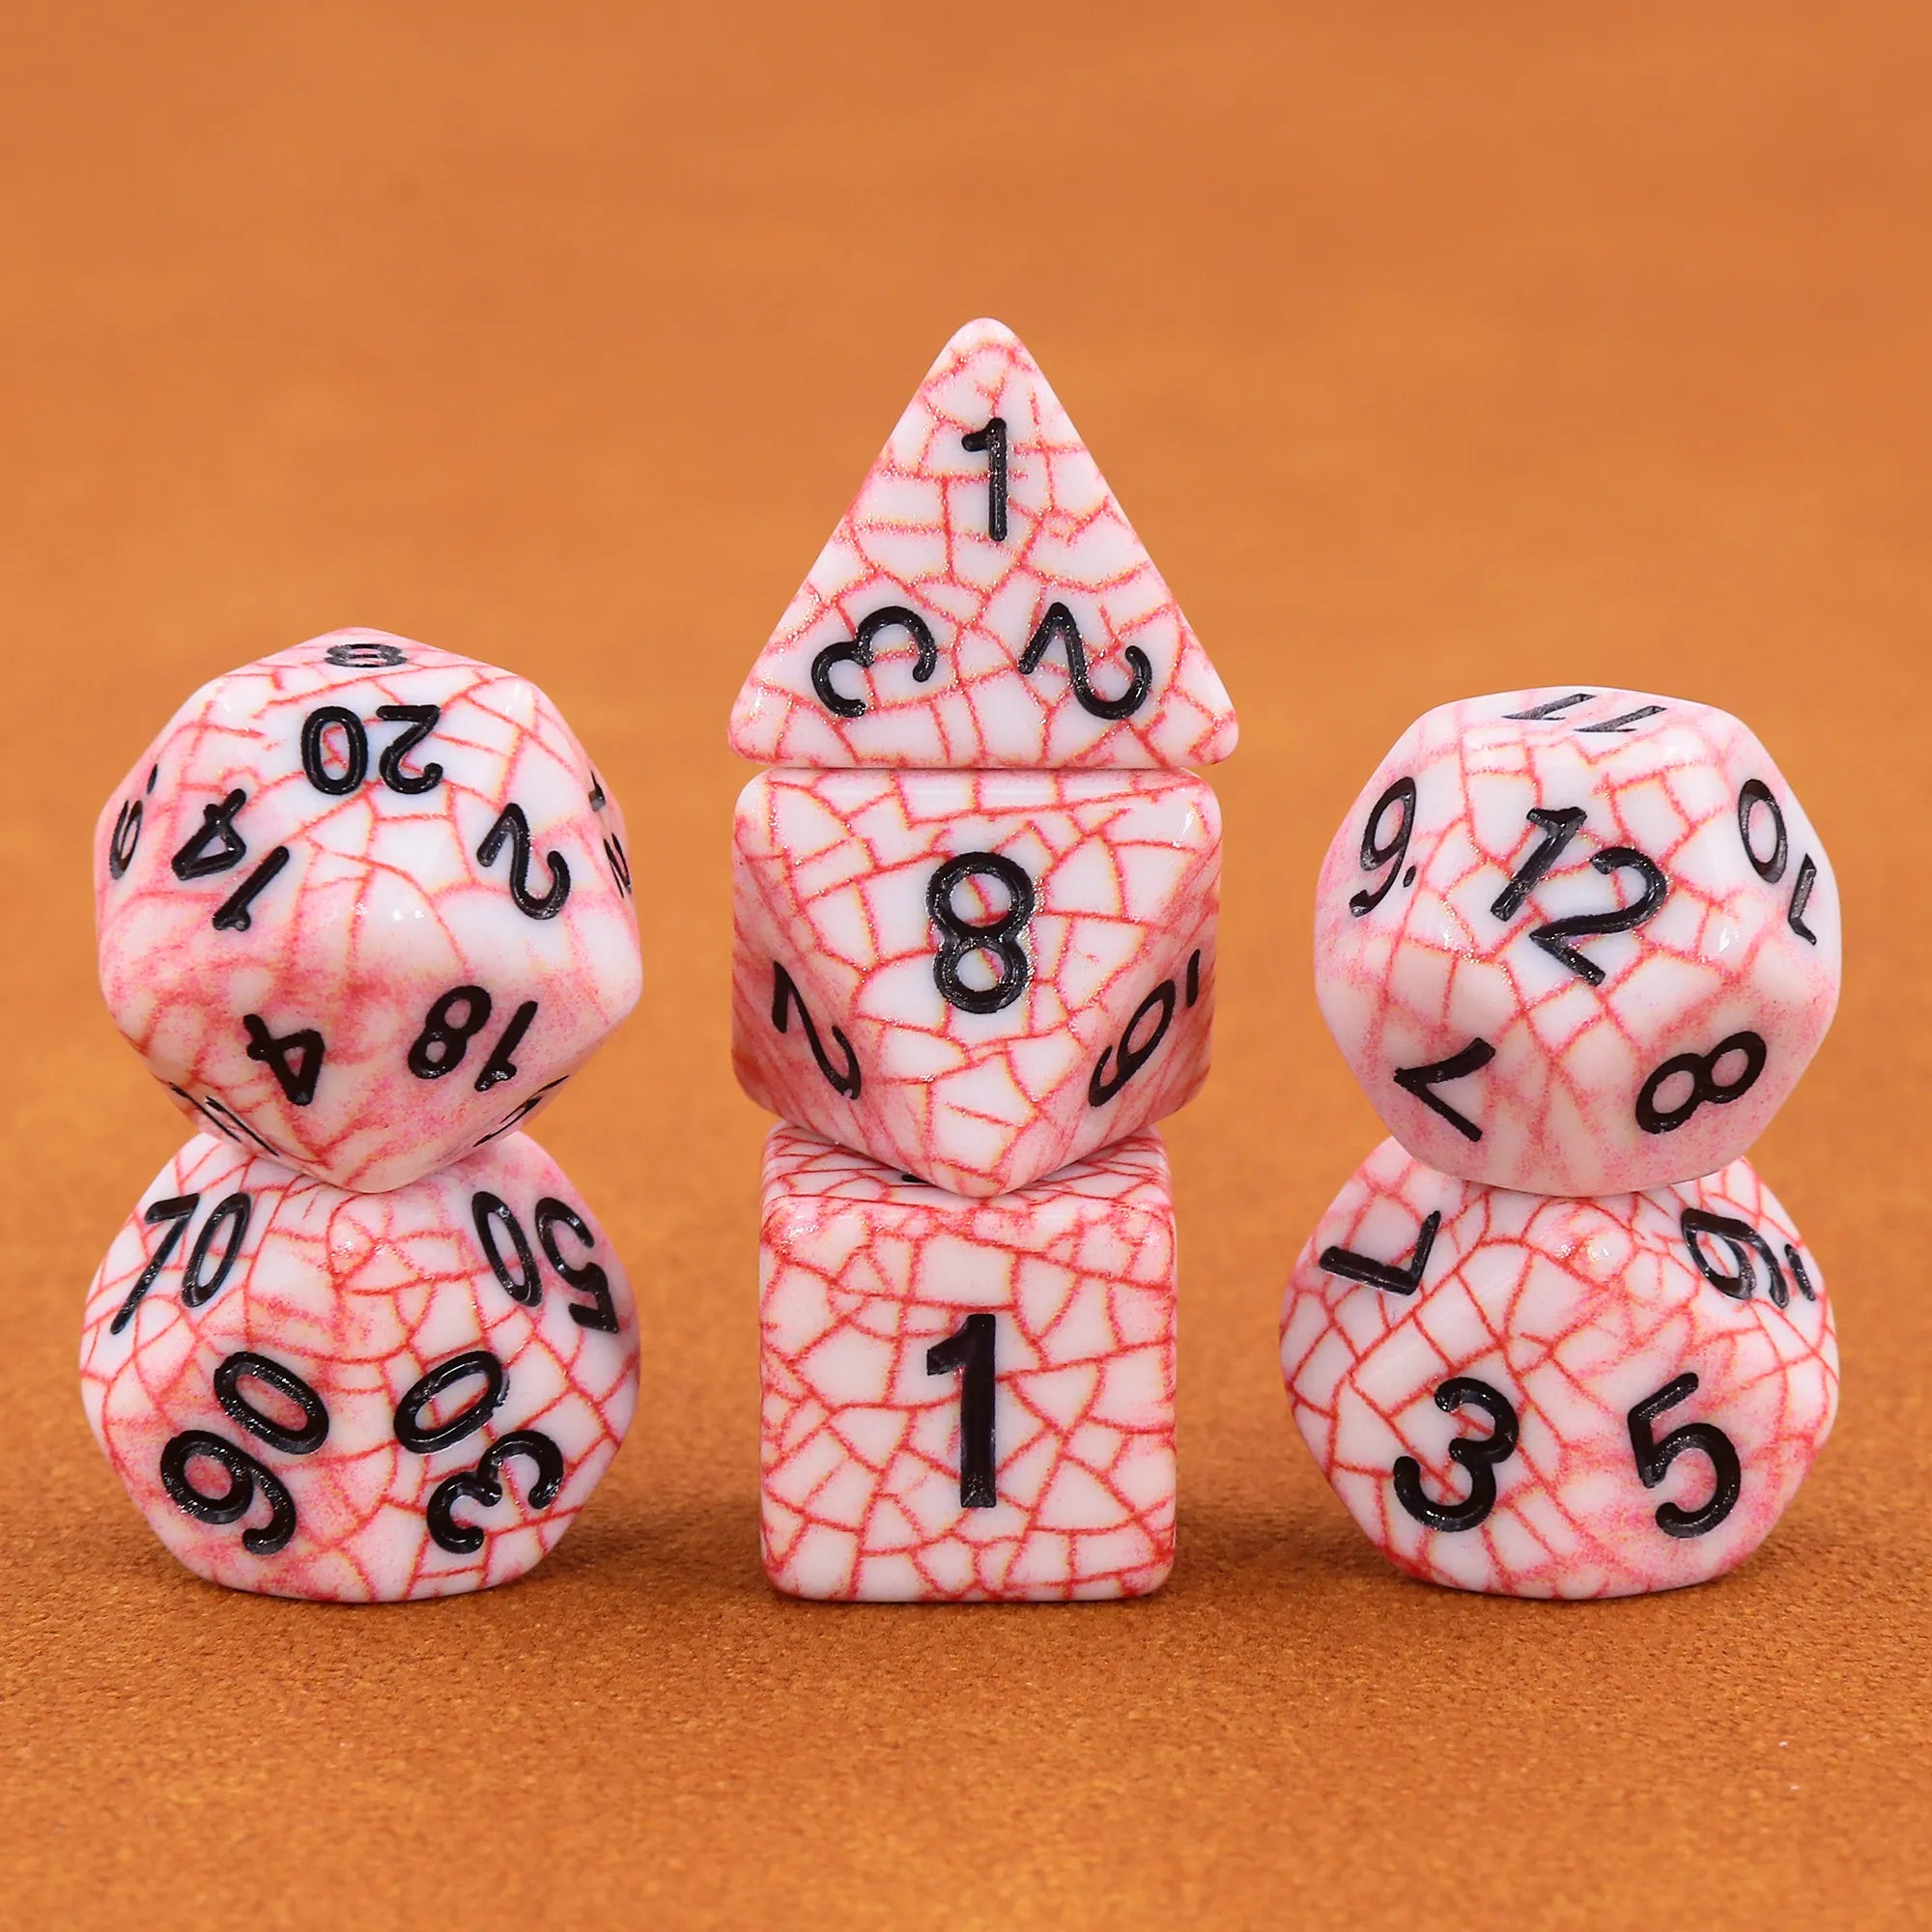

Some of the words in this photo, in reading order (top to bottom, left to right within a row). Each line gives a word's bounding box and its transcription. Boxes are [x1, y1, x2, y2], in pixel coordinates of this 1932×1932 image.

[962, 416, 1008, 542] 1
[811, 605, 938, 719] 3
[1018, 601, 1152, 721] 2
[300, 705, 443, 795] 20
[171, 787, 290, 932] 14
[477, 803, 571, 921] 2
[1490, 806, 1667, 987] 12
[1738, 778, 1818, 947] 10
[925, 851, 1036, 1015] 8
[242, 1013, 327, 1107] 4
[407, 984, 538, 1093] 18
[772, 960, 862, 1100] 2
[1393, 1037, 1496, 1143] 7
[1634, 1030, 1768, 1135] 8
[110, 1192, 252, 1335] 70
[470, 1190, 620, 1335] 50
[1319, 1209, 1441, 1296] 7
[159, 1350, 330, 1555] 90
[392, 1350, 564, 1555] 30
[925, 1313, 997, 1509] 1
[1392, 1376, 1520, 1533] 3
[1627, 1372, 1742, 1539] 5
